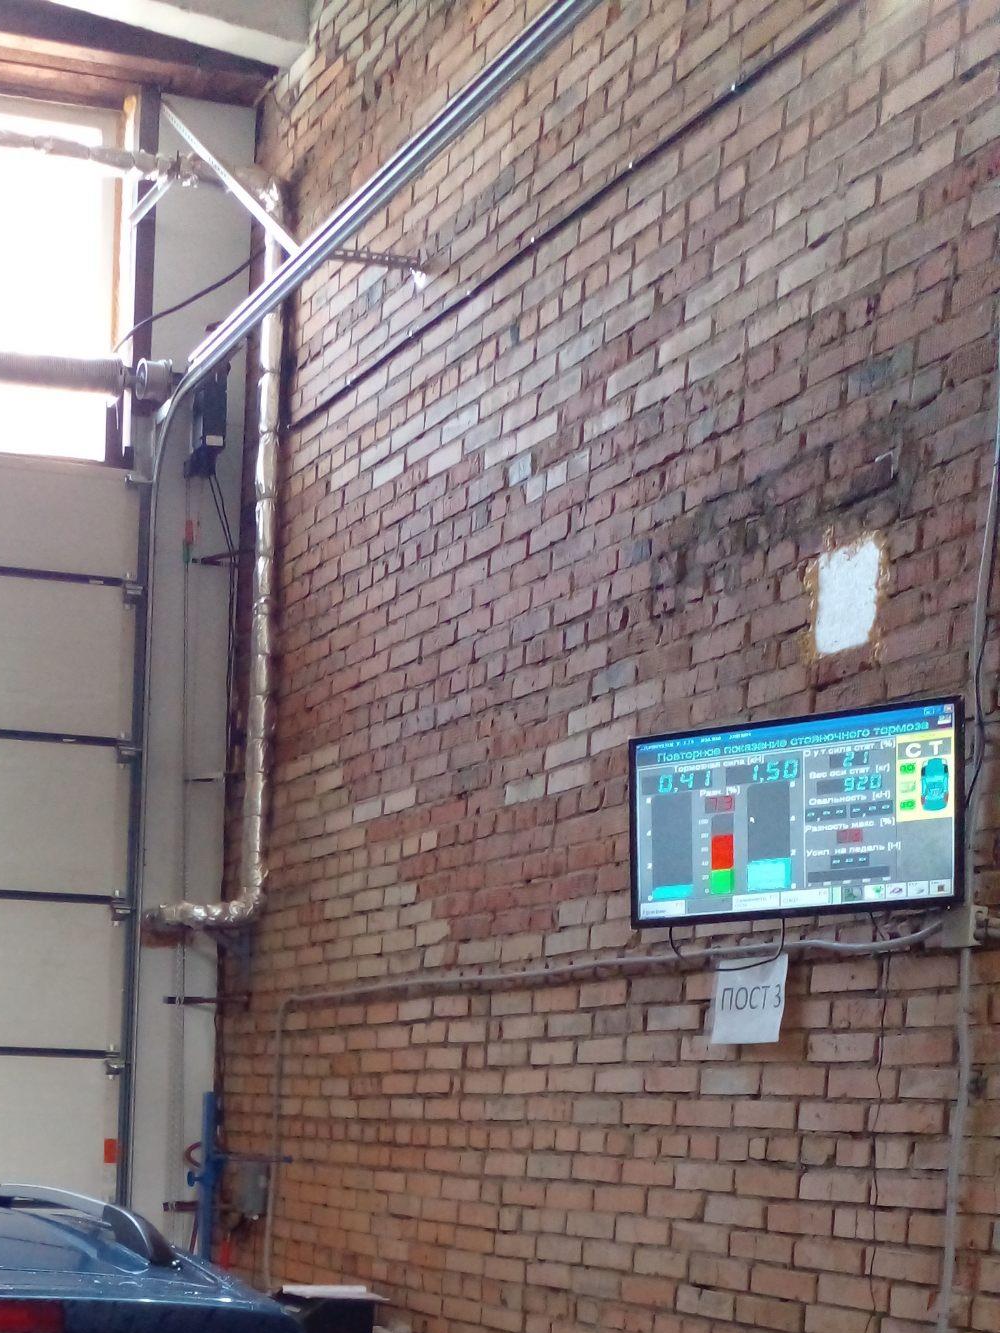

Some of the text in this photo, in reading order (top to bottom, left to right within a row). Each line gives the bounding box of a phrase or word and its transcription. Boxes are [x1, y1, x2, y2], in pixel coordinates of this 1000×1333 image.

[873, 721, 930, 737] тормоза
[721, 984, 782, 1011] ПОСТ 3
